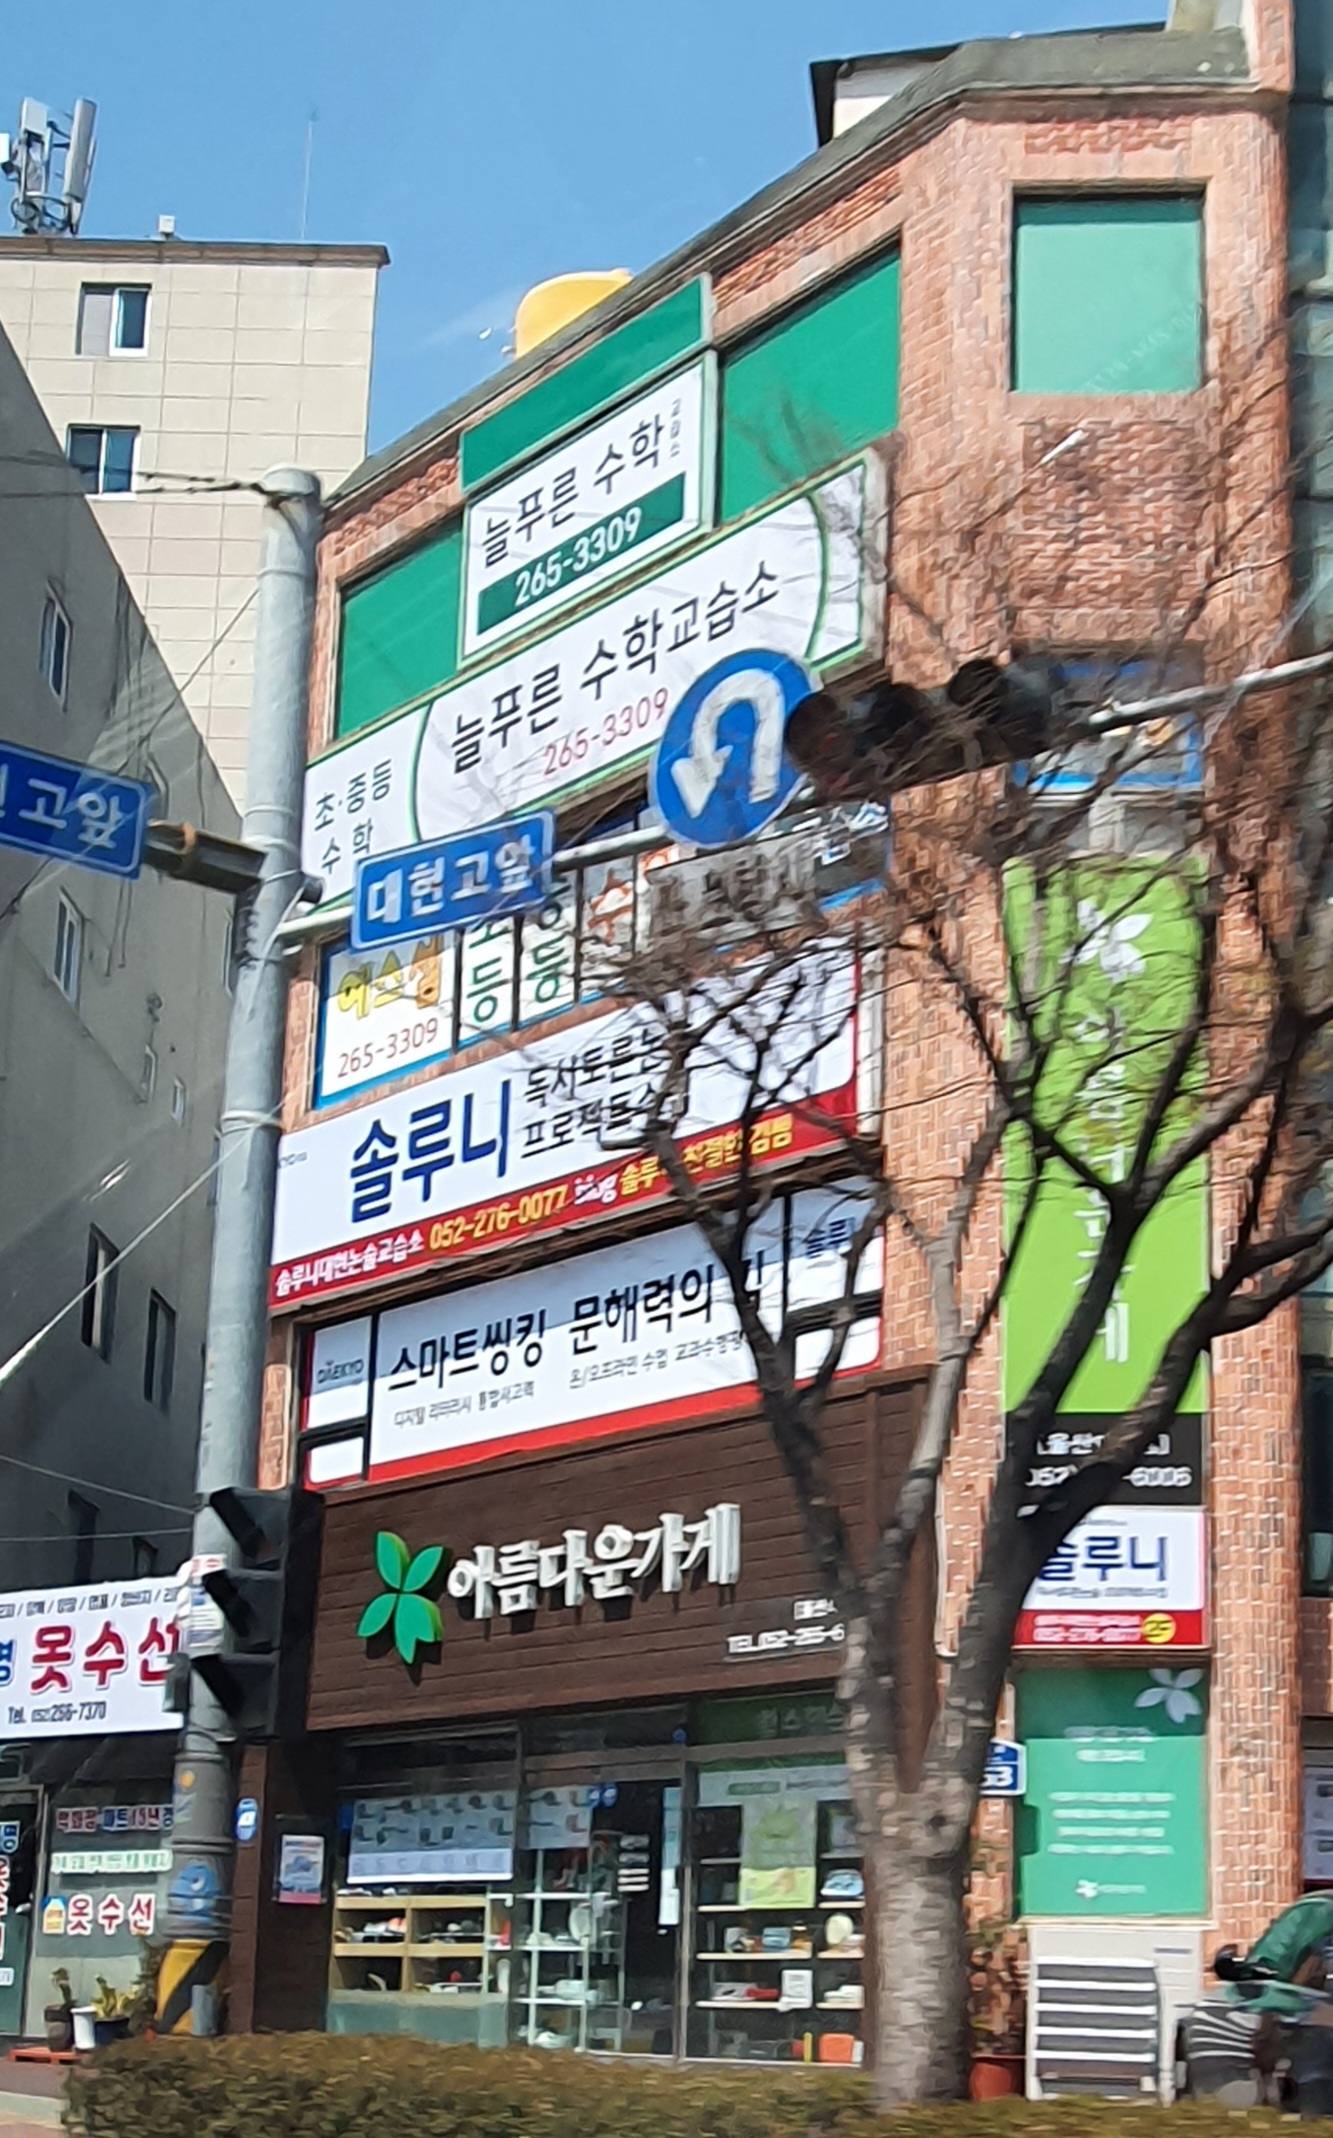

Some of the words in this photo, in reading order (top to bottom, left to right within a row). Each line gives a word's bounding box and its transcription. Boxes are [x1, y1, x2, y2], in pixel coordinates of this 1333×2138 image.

[481, 466, 580, 568] 늘푸른
[594, 413, 664, 494] 수학
[514, 507, 643, 607] 265-3309
[451, 664, 563, 774] 늘푸른
[580, 560, 780, 702] 수학교습소
[543, 687, 670, 778] 265-3309
[0, 764, 119, 848] 고앞
[321, 817, 373, 874] 수학
[366, 835, 536, 926] 대현고앞
[337, 1018, 439, 1079] 265-3309
[350, 1079, 511, 1223] 솔루니
[429, 1184, 569, 1251] 052-276-0077
[388, 1308, 546, 1392] 스마트씽킹
[569, 1263, 714, 1355] 문해력의
[446, 1503, 741, 1620] 아름다운가게
[69, 1897, 155, 1933] 옷수선
